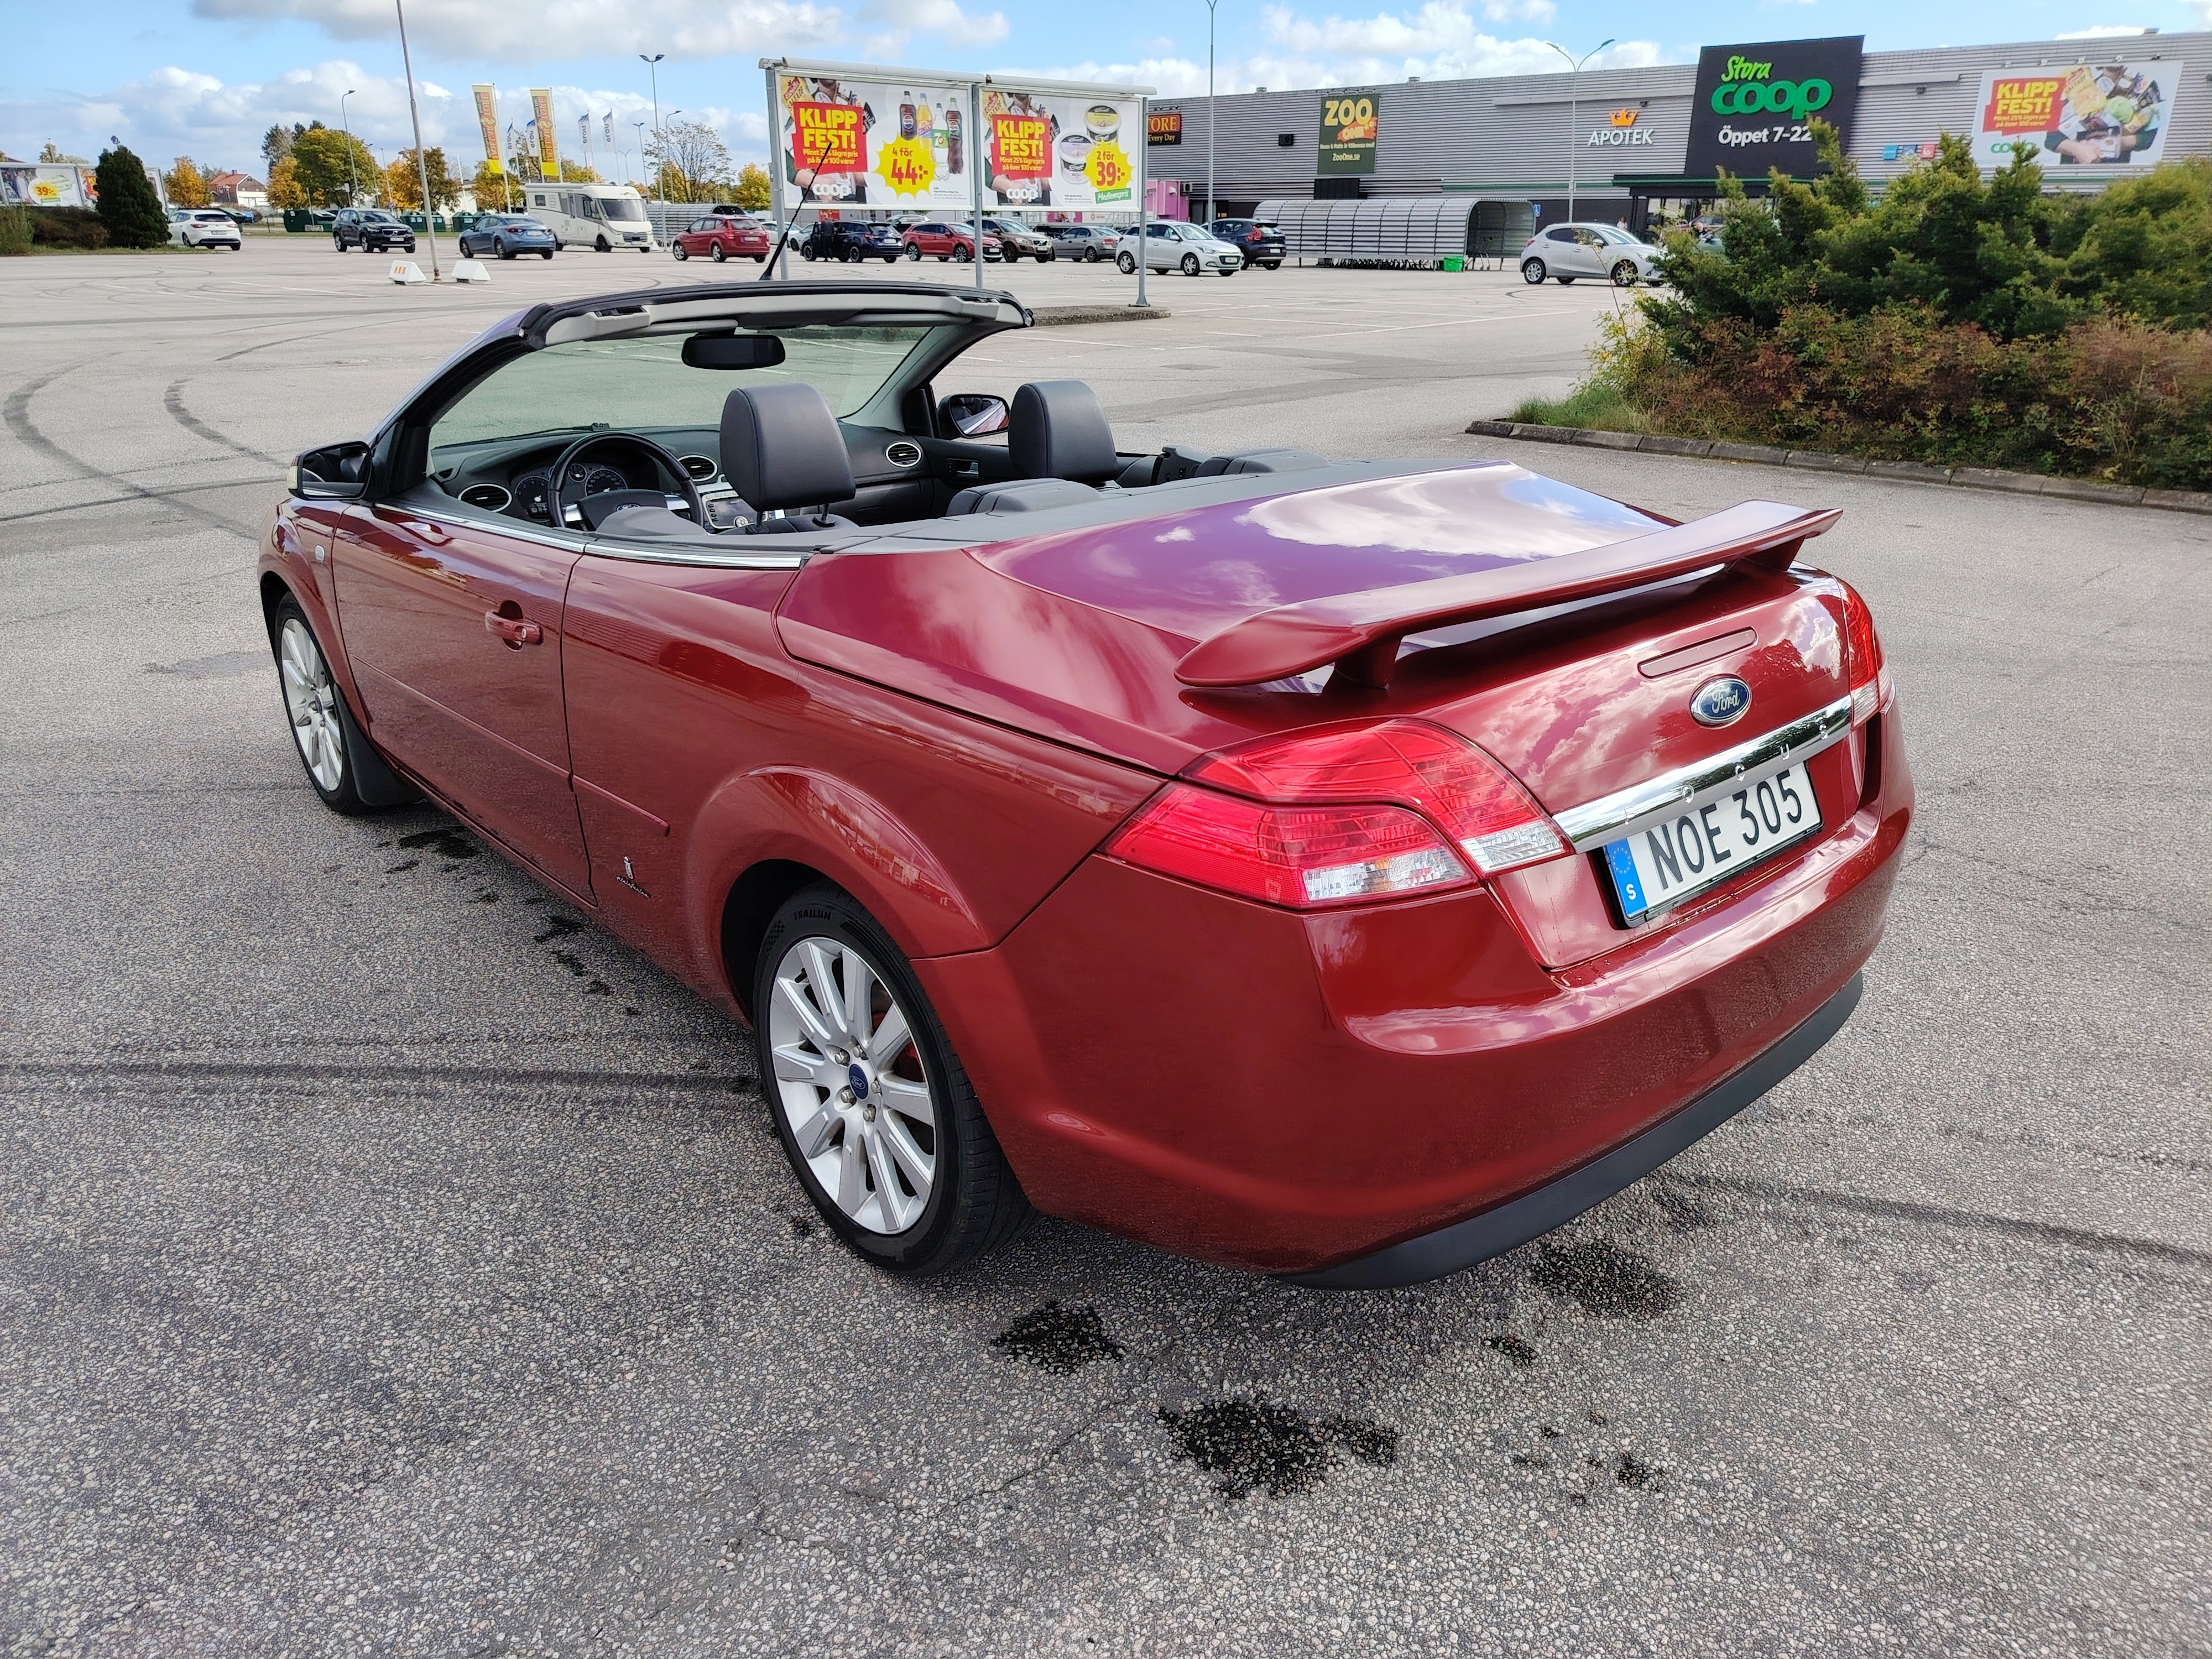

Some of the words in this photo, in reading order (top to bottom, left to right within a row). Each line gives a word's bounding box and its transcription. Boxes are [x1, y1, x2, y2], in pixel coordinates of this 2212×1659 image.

[1721, 55, 1772, 82] Stora
[1711, 79, 1832, 119] coop
[1996, 81, 2058, 99] KLIPP
[1324, 98, 1373, 126] ZOO
[1996, 97, 2053, 115] FEST!
[800, 108, 857, 129] KLIPP
[997, 120, 1045, 139] KLIPP
[1148, 134, 1163, 143] Every
[1164, 134, 1176, 143] Day
[1342, 126, 1364, 140] ONE
[1587, 128, 1653, 146] APOTEK
[1718, 125, 1769, 147] Öppet
[1773, 126, 1812, 142] 7-22
[804, 129, 856, 149] FEST!
[1000, 138, 1044, 157] FEST!
[893, 148, 898, 156] 4
[900, 148, 913, 156] för
[1097, 151, 1101, 160] 2
[1103, 151, 1114, 160] för
[1097, 161, 1125, 186] 39:-
[812, 184, 852, 199] coop
[1006, 188, 1039, 202] coop
[1712, 687, 1740, 713] Ford
[1646, 803, 1731, 890] NOE
[1732, 769, 1802, 846] 305
[1626, 884, 1637, 900] S
[797, 909, 831, 921] SAILUN
